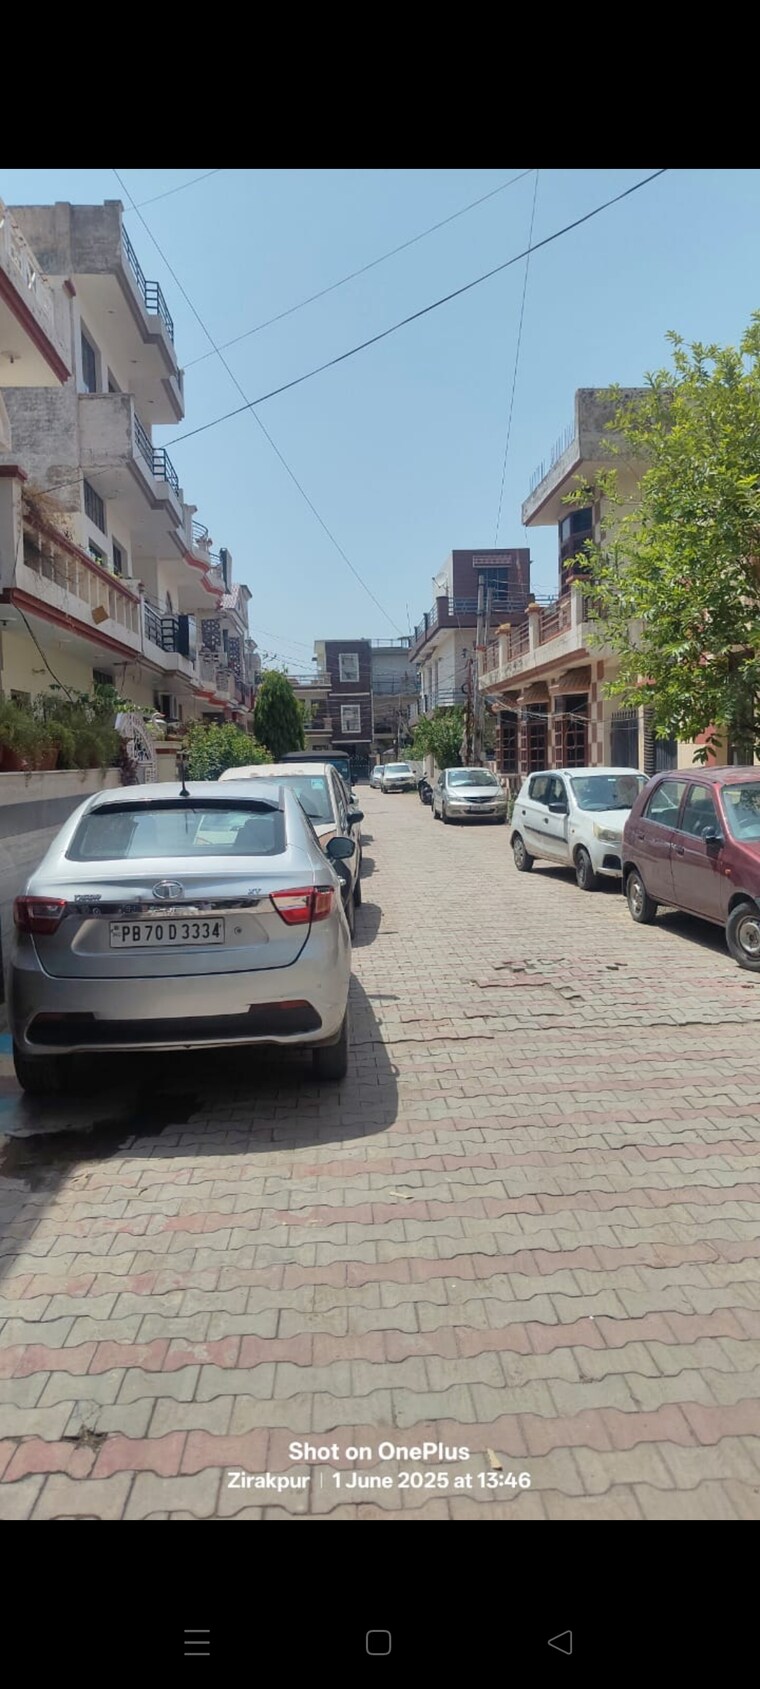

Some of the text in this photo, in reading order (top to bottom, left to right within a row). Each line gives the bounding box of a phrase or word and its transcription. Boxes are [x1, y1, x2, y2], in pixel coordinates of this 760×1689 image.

[122, 922, 220, 942] PB 70 D 3334
